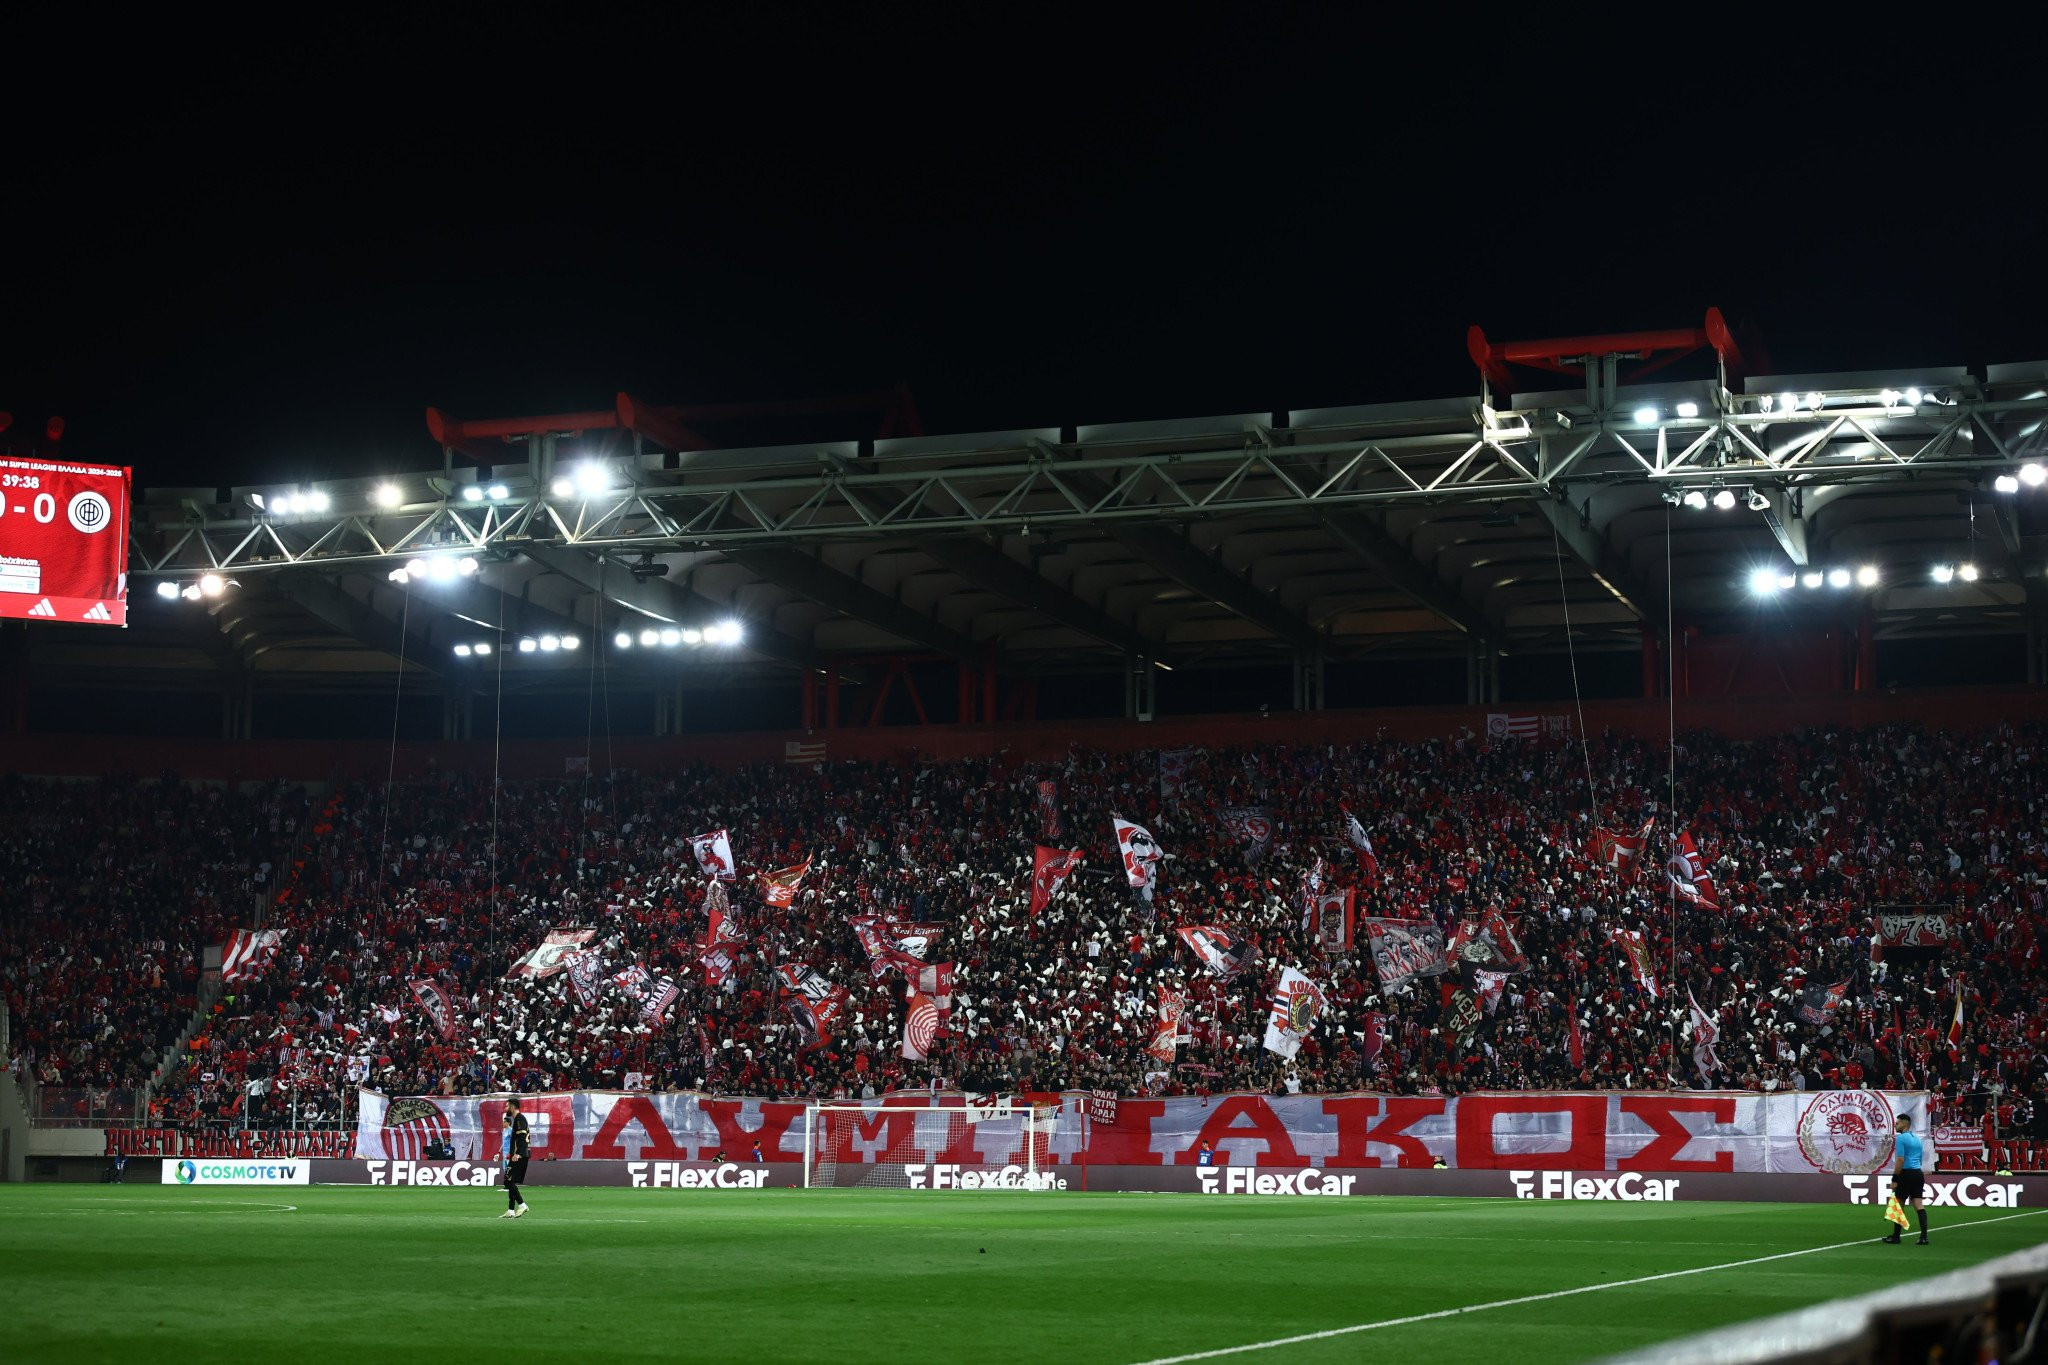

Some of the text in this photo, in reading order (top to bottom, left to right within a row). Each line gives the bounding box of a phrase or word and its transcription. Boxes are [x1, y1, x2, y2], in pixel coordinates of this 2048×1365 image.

[2, 473, 40, 489] 39:38
[9, 461, 30, 469] SUPER
[31, 463, 57, 472] LEAGUE
[58, 465, 87, 474] ΕΛΛΑΔΑ
[87, 468, 123, 477] 2024-2025
[1819, 1093, 1887, 1130] ΟΛΥΜΠΙΑΚΟΣ
[104, 1128, 177, 1156] PORTO
[201, 1165, 296, 1179] COSMOTE TV
[391, 1161, 500, 1187] FlexCar
[653, 1162, 769, 1189] FlexCar
[1226, 1167, 1356, 1195] FlexCar
[1542, 1171, 1680, 1202] FlexCar
[1877, 1175, 2024, 1207] FexCar
